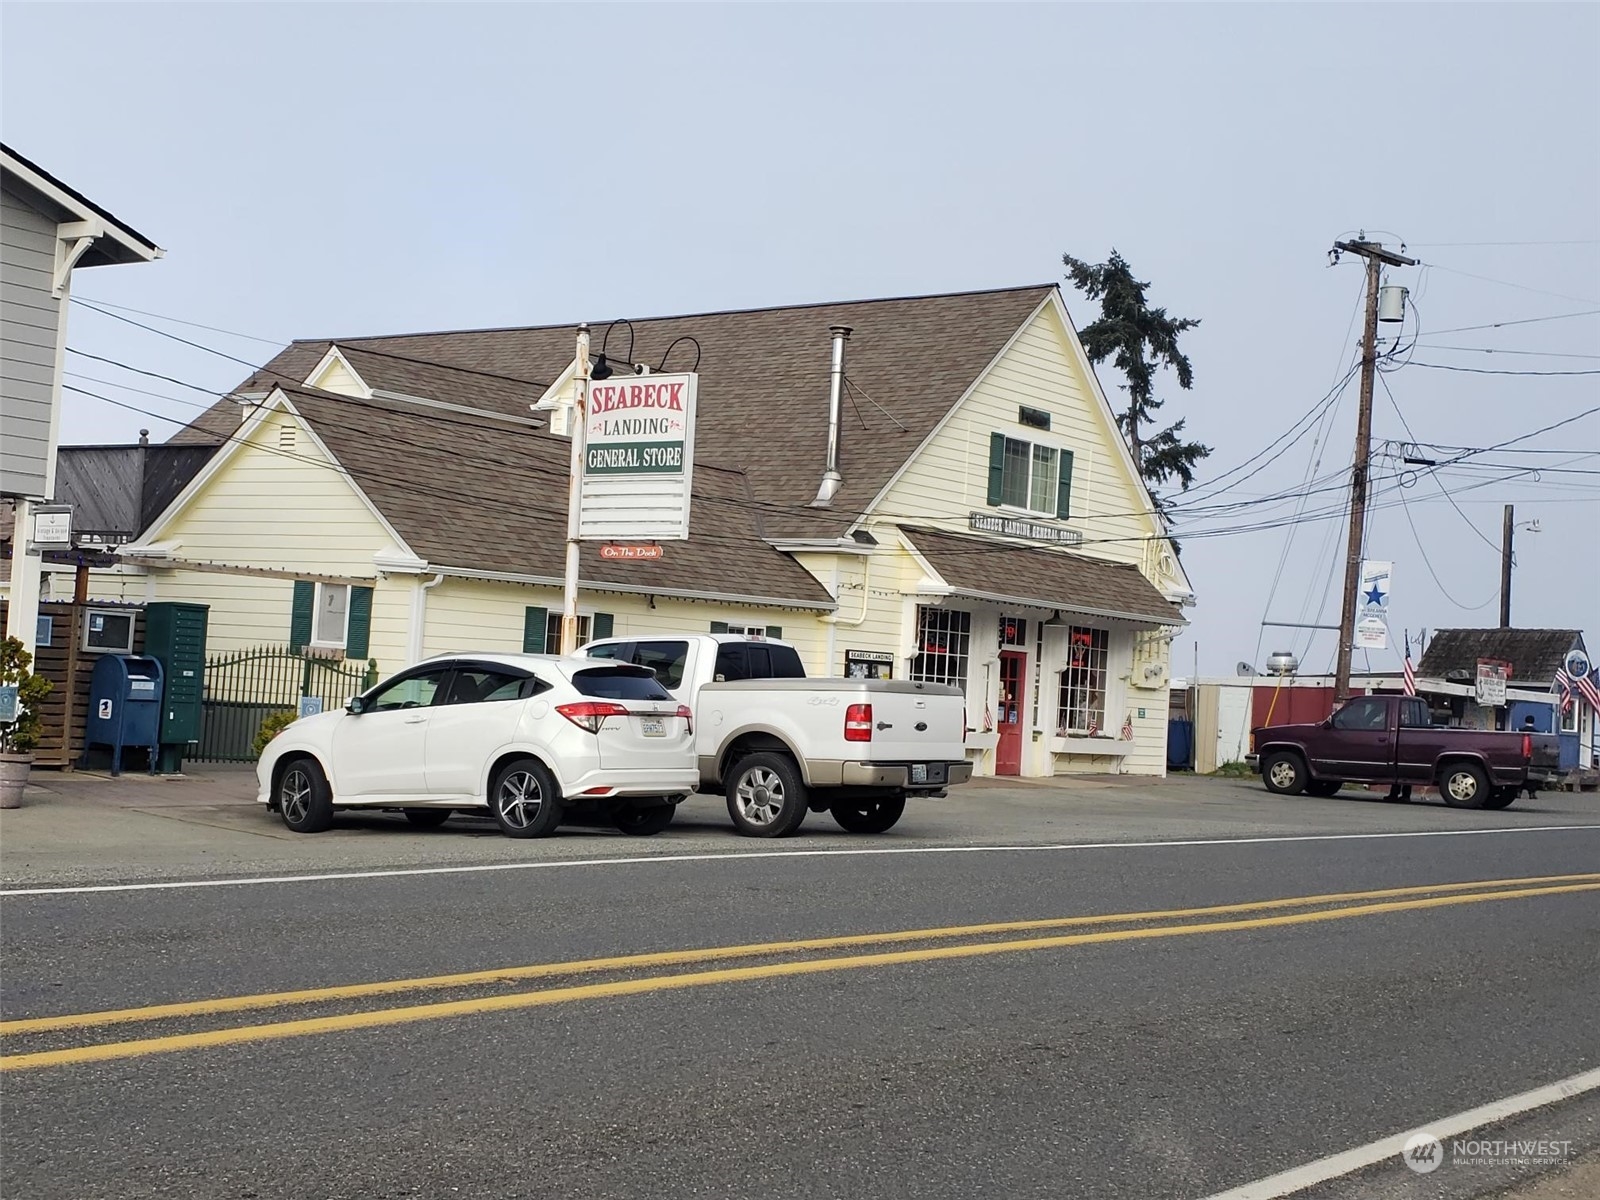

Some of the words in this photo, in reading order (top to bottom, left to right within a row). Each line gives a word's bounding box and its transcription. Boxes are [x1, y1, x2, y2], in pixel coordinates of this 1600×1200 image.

[592, 383, 684, 415] SEABECK
[603, 418, 669, 436] LANDING
[588, 448, 640, 468] GENERAL
[643, 447, 681, 467] STORE
[975, 514, 1003, 532] SEABECK
[1004, 519, 1031, 537] LANDING
[1032, 525, 1058, 541] GENERAL
[604, 547, 618, 556] On
[619, 547, 634, 556] The
